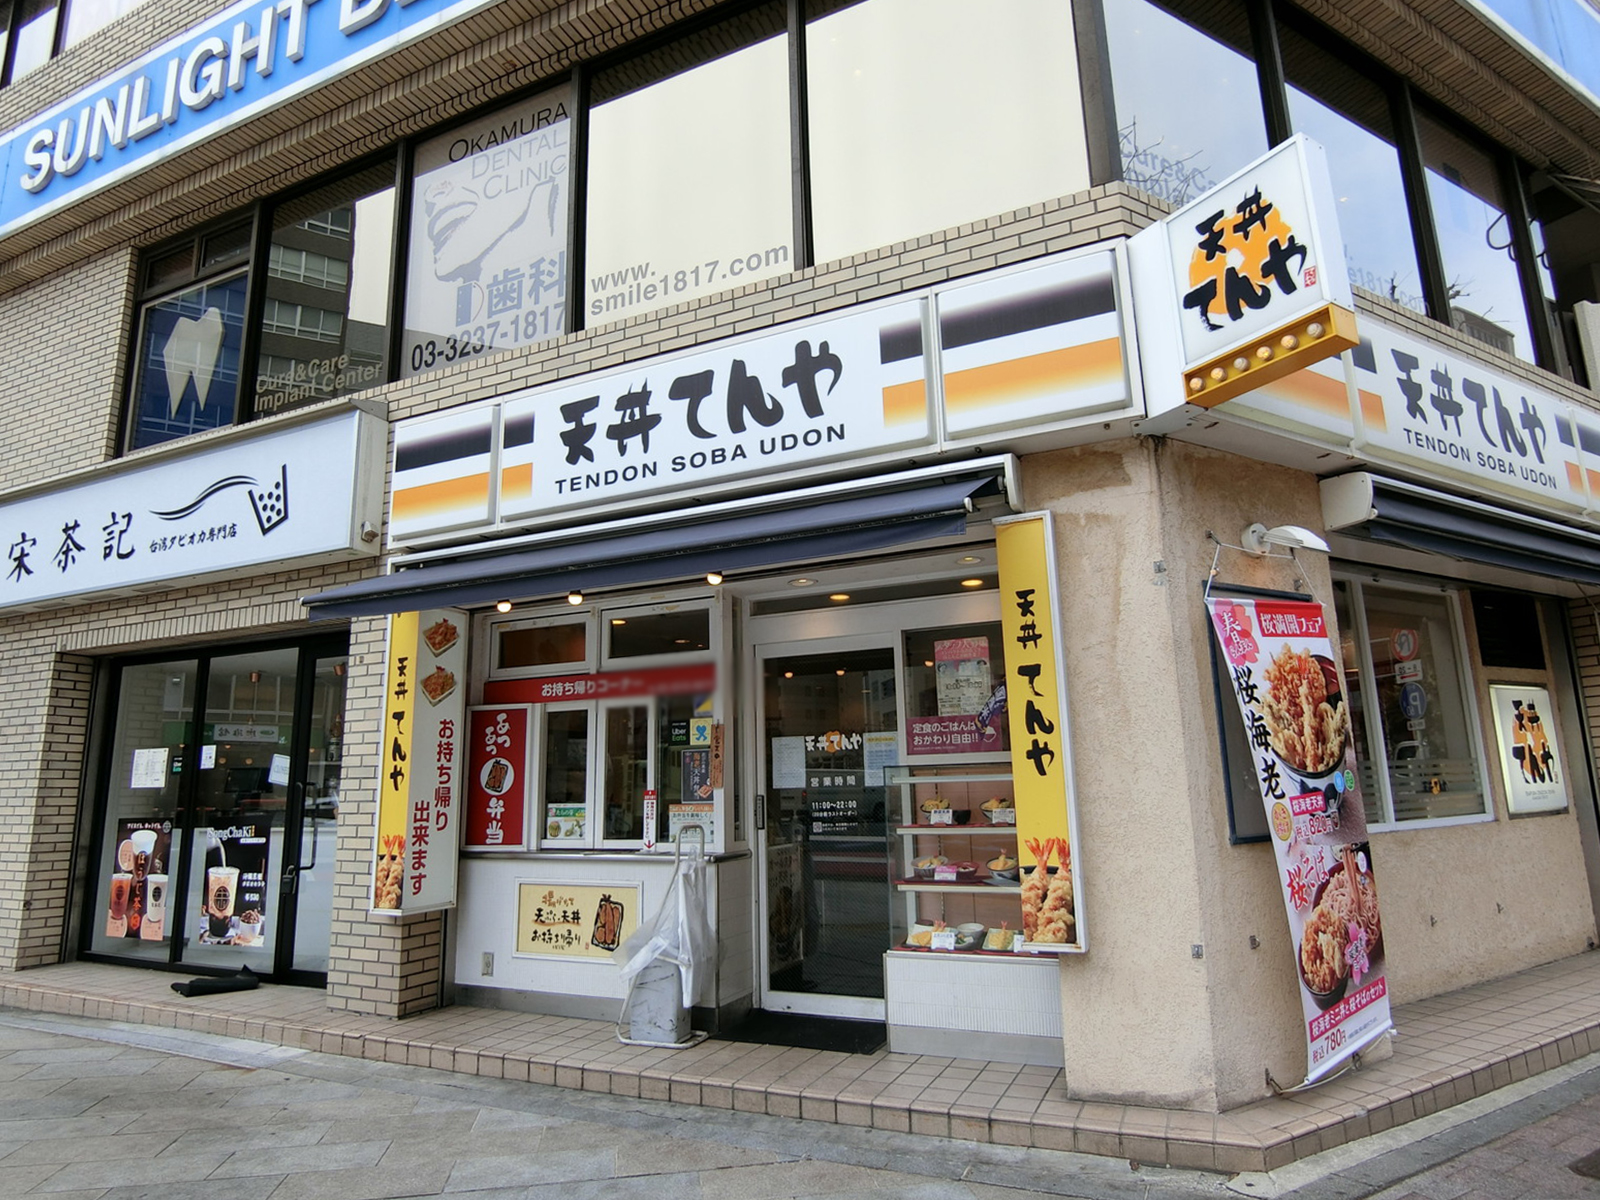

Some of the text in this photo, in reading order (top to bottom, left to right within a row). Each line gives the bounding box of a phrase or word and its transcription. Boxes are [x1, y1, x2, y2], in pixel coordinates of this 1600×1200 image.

[20, 0, 319, 194] SUNLIGHT
[448, 101, 569, 164] OKAMURA
[471, 128, 568, 180] DENTAL
[483, 154, 568, 200] CLINIC
[486, 251, 567, 319] 歯科
[590, 259, 657, 293] www.
[590, 244, 789, 316] smile1817.com
[1183, 235, 1308, 332] てんや
[411, 302, 567, 372] 03-3237-1817
[254, 363, 383, 412] Implant Center
[256, 354, 350, 393] Cure&Care
[559, 339, 844, 466] 天丼てんや
[1390, 348, 1547, 465] 天丼てんや
[555, 423, 846, 495] TENDON SOBA UDON
[1402, 427, 1558, 490] TENDON SOBA UDON
[149, 522, 238, 554] 台湾タピオカ専門店
[1260, 611, 1322, 635] 桜満開フェア
[1015, 588, 1055, 777] 天丼てんや
[389, 656, 409, 791] 天丼てんや
[671, 727, 687, 735] Uber
[671, 734, 687, 742] Eats
[804, 732, 862, 752] 天丼てんや
[912, 721, 977, 734] 定食のごはんは
[1233, 665, 1286, 800] 桜海老
[434, 719, 455, 831] お持ち帰り
[810, 775, 856, 788] 営業時間
[1511, 739, 1555, 784] てんや
[410, 800, 430, 896] 出来ます
[486, 797, 505, 845] 弁当
